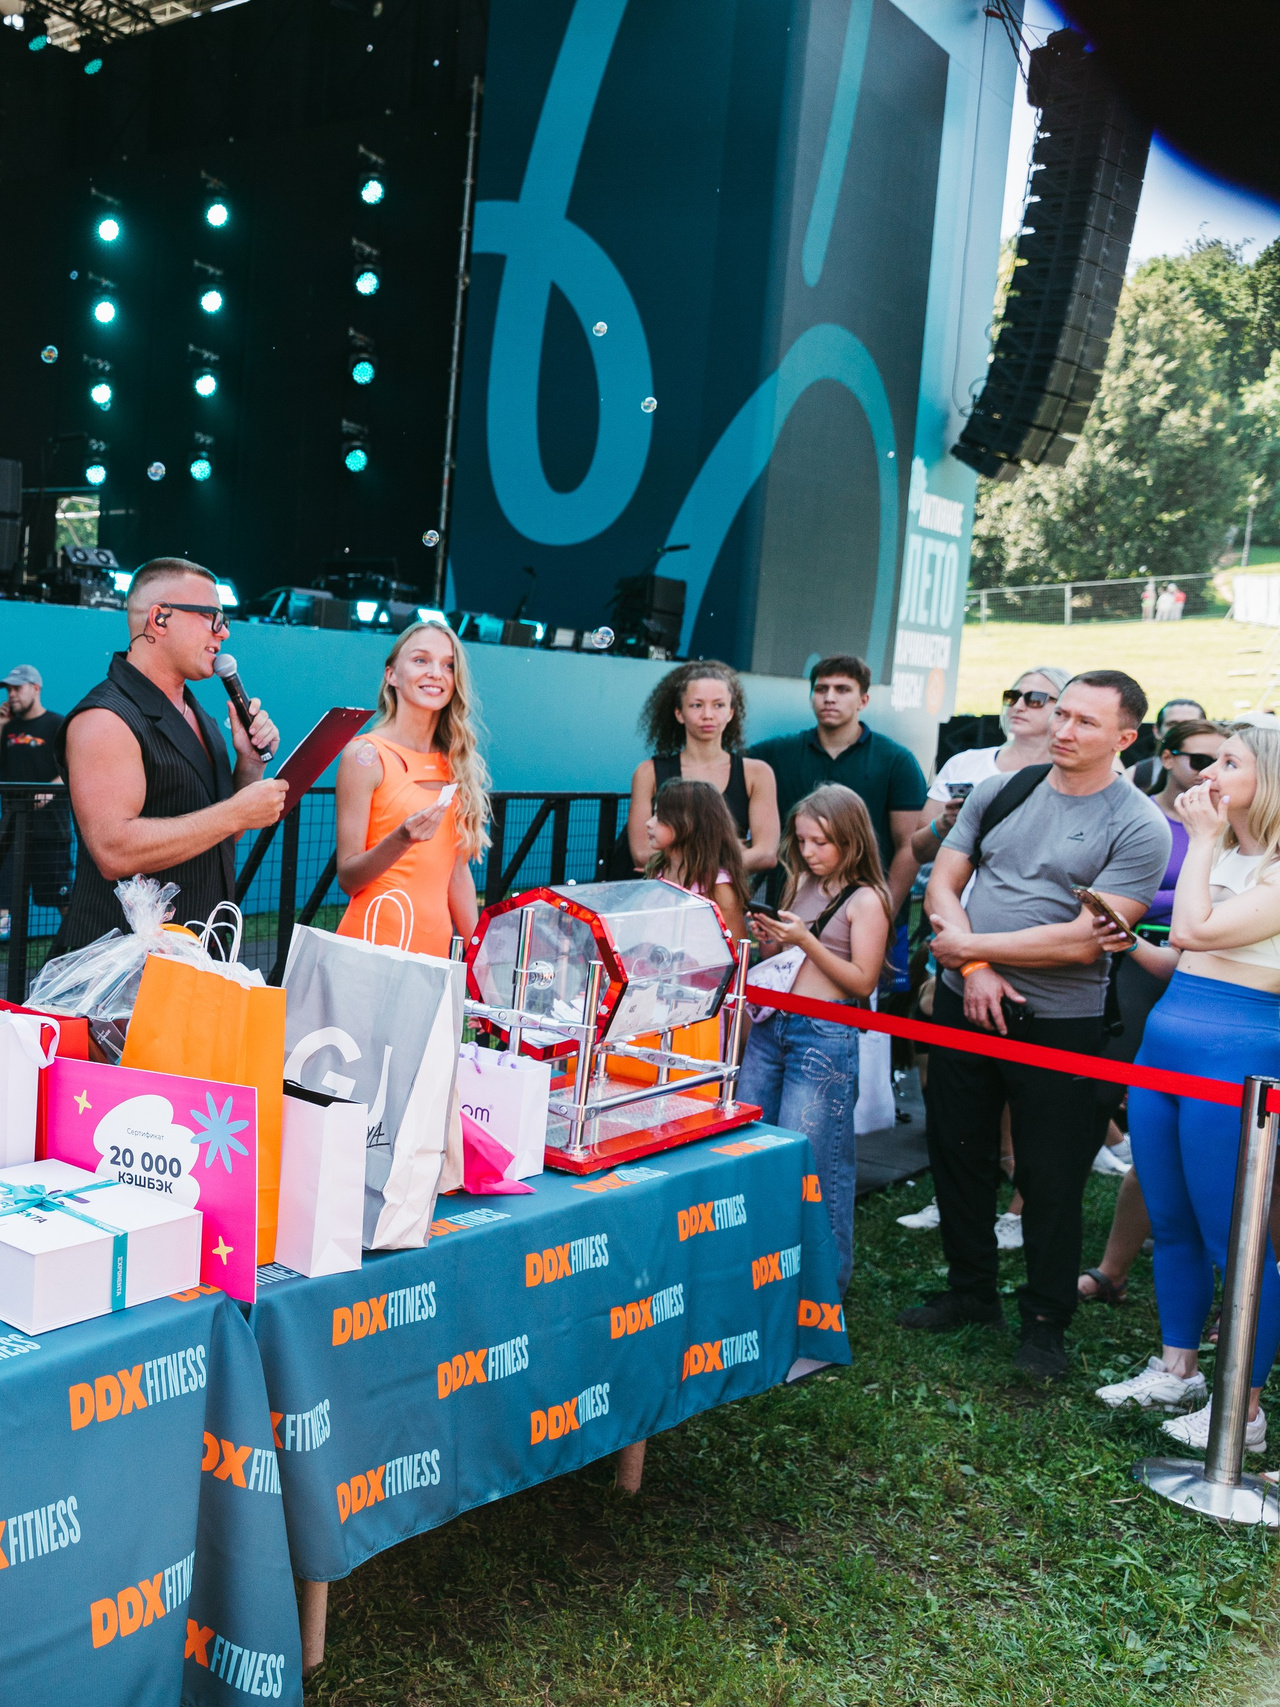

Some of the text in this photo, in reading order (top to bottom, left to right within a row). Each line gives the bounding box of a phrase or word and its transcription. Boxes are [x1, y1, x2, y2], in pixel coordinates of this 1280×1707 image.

[900, 533, 959, 629] ЛЕТО
[110, 1145, 181, 1178] 20 000
[127, 1127, 164, 1140] Сертификат
[118, 1171, 173, 1194] КЭШБЭК
[428, 1208, 511, 1239] DXFITNESS
[677, 1194, 747, 1242] DDXFITNESS
[525, 1233, 610, 1289] DDXFITNESS
[332, 1281, 437, 1346] DDXFITNESS
[610, 1283, 684, 1340] DDXFITNESS
[437, 1335, 529, 1400] DDXFITNESS
[683, 1330, 760, 1382] DDXFITNESS
[68, 1345, 207, 1431] DDXFITNESS
[336, 1449, 441, 1523] DDXFITNESS
